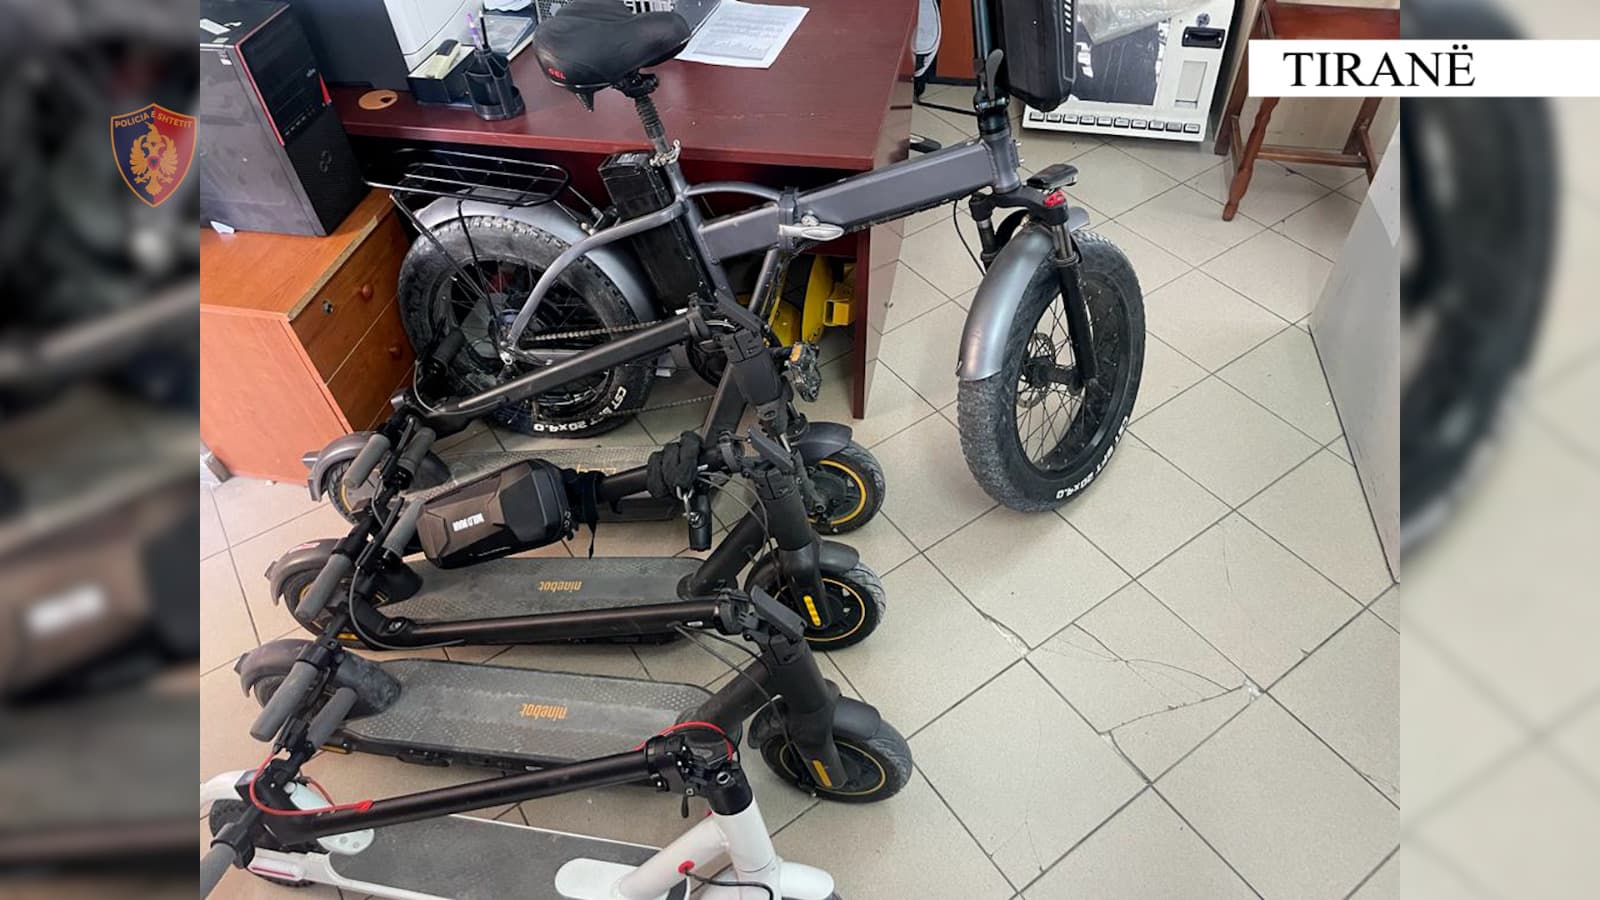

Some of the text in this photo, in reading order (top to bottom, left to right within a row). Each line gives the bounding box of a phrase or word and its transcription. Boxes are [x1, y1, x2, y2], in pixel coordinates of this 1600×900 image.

[611, 386, 627, 410] CST
[535, 580, 583, 593] ninebot
[519, 702, 569, 722] ninebot
